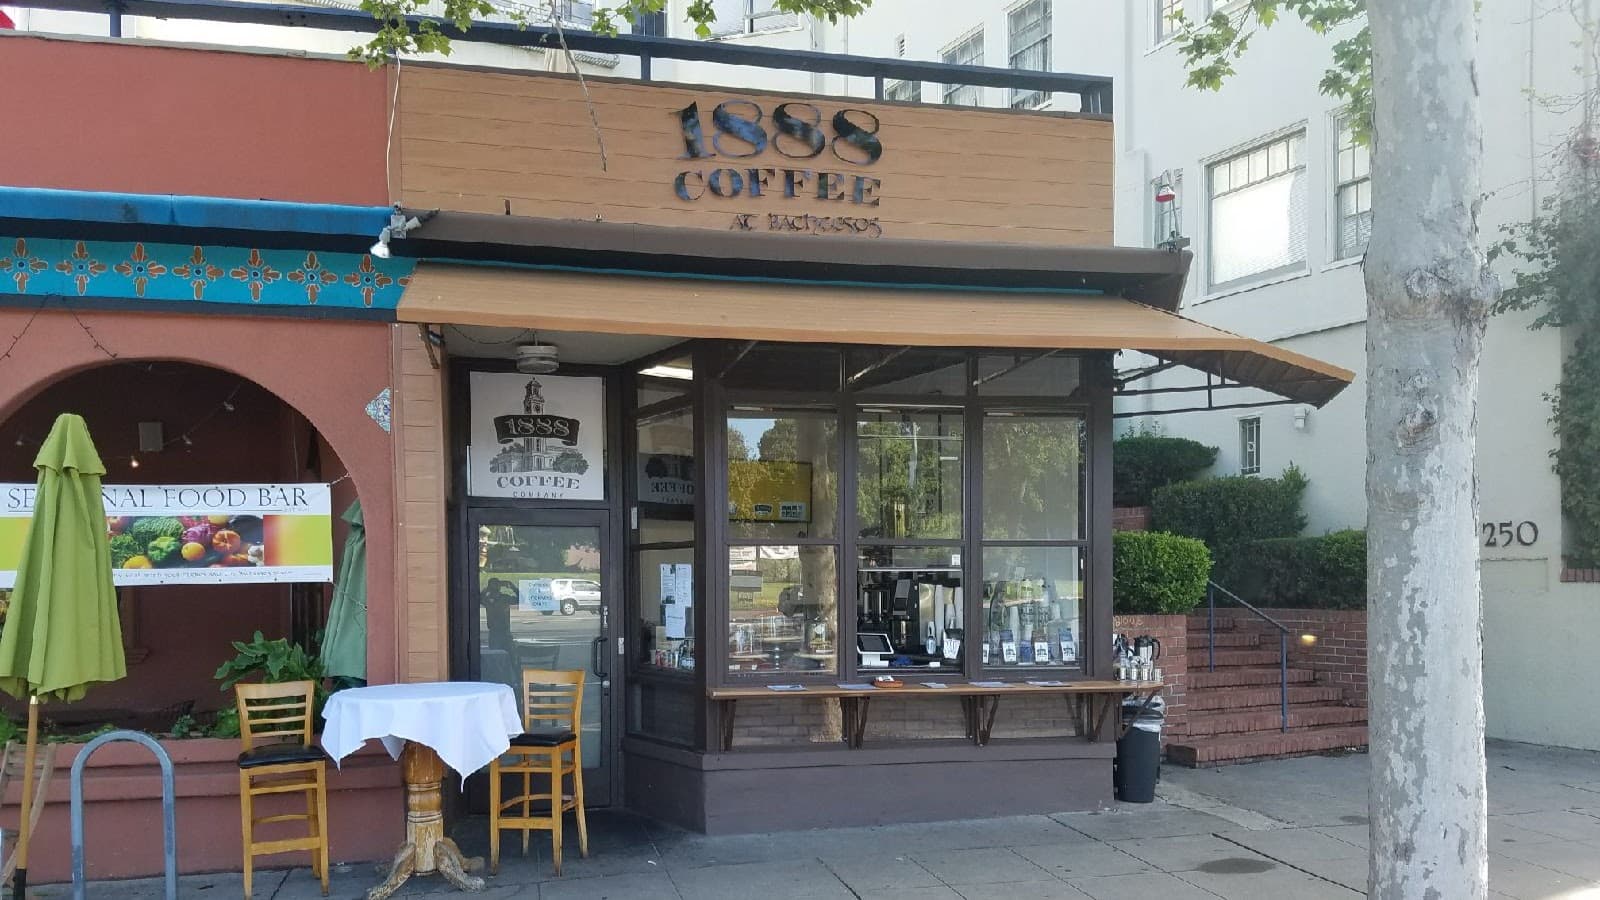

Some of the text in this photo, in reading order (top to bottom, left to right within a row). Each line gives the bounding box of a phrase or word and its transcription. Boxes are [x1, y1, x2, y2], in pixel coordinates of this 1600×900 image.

[669, 100, 883, 166] 1888
[675, 168, 881, 207] COFFEE
[504, 418, 569, 436] 1888
[496, 475, 580, 489] COFFEE
[8, 487, 309, 508] SENAL FOOD BAR
[1482, 520, 1539, 548] 250
